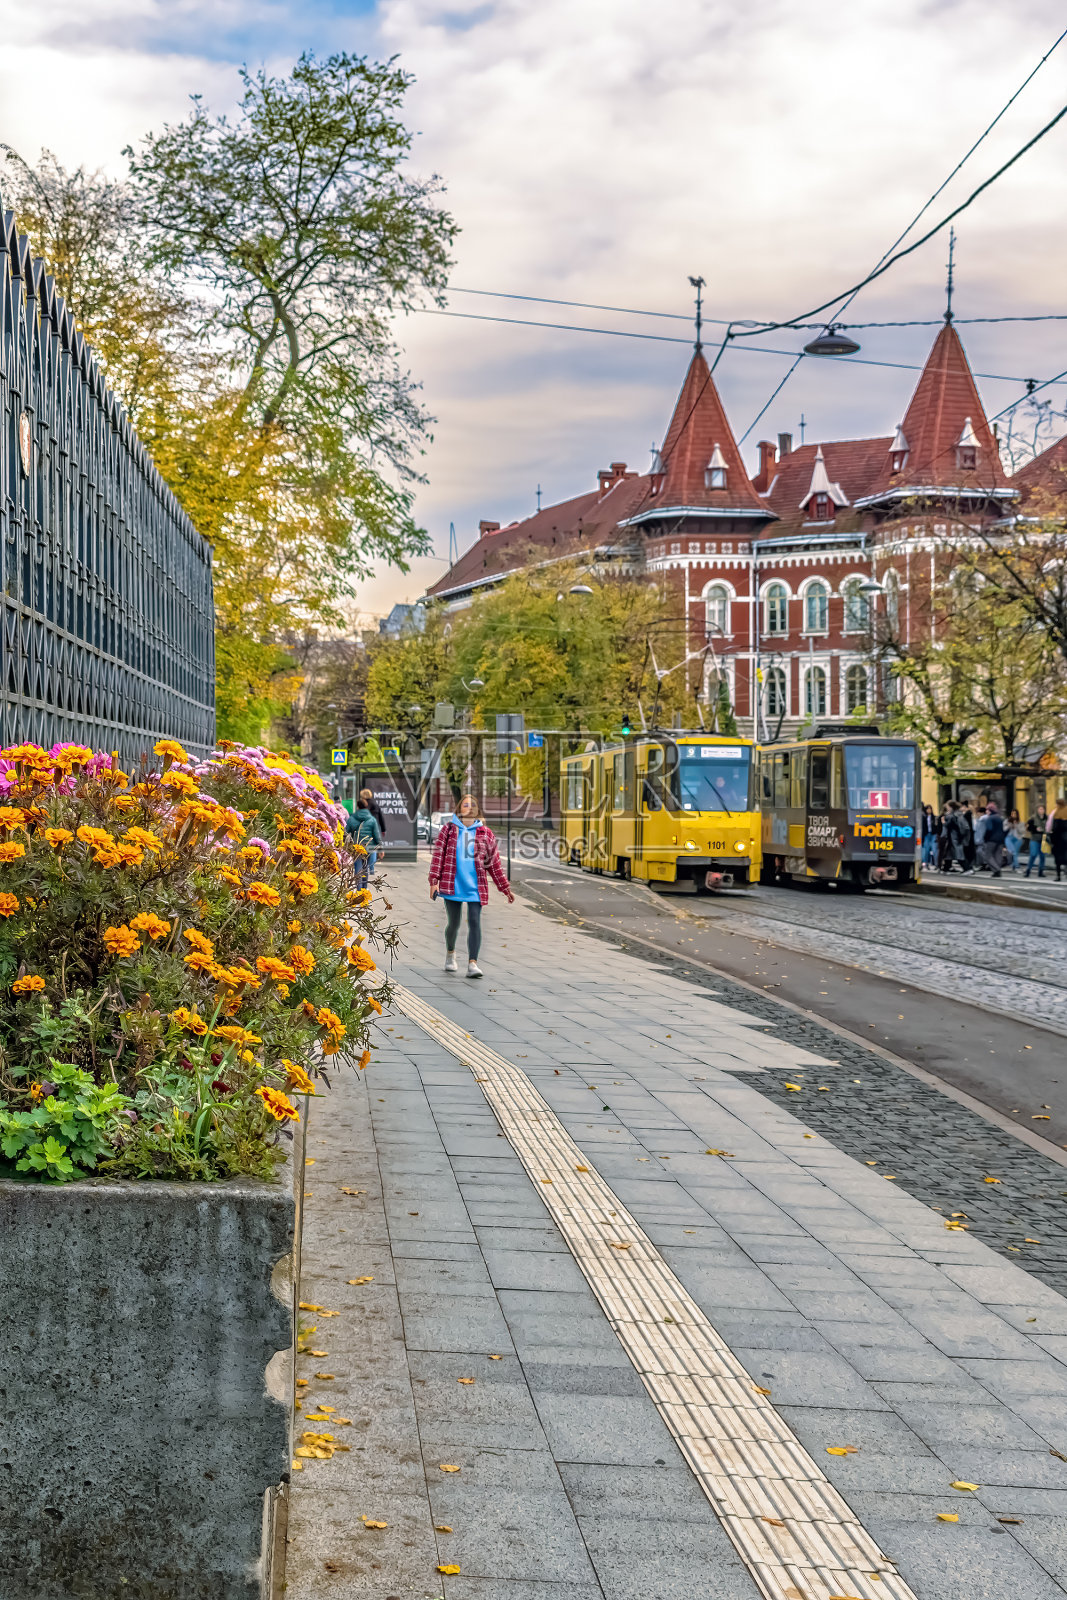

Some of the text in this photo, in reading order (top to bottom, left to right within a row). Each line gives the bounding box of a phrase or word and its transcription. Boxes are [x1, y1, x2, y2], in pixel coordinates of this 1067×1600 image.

[688, 748, 695, 756] 9
[373, 791, 407, 799] MENTAL
[375, 799, 409, 807] UPPORT
[874, 793, 883, 808] 1
[381, 807, 408, 815] EATER
[808, 816, 829, 826] ТВОЯ
[807, 826, 837, 837] СМАРТ
[853, 822, 914, 838] hotline
[707, 841, 726, 850] 1101
[807, 836, 840, 848] ЗВИЧКА
[869, 840, 894, 851] 1145
